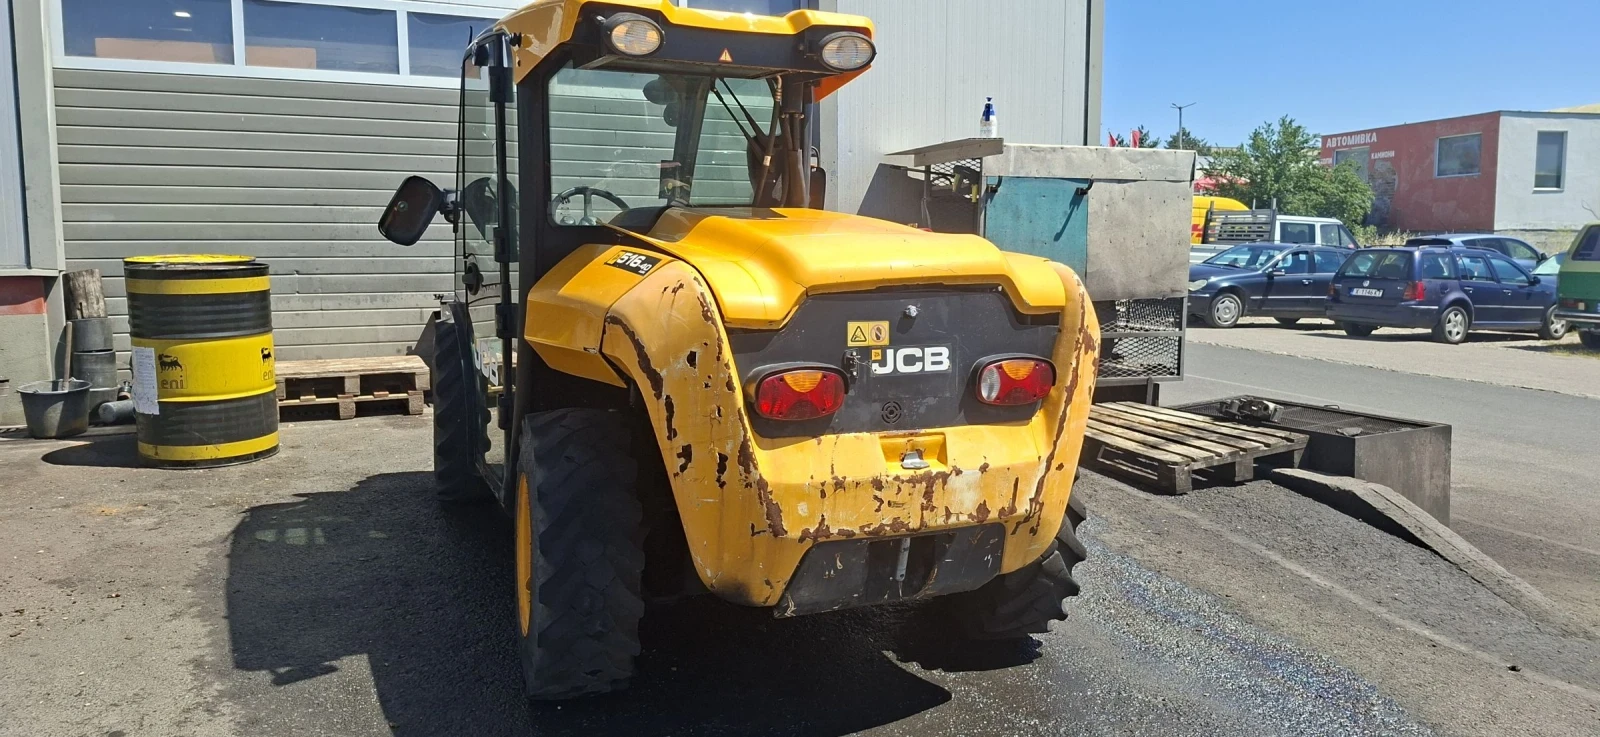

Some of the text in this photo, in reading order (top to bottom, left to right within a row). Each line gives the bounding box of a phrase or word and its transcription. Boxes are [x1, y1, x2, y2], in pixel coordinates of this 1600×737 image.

[1326, 132, 1377, 148] АВТОМИВКА
[871, 347, 950, 374] JCB
[160, 375, 184, 389] eni
